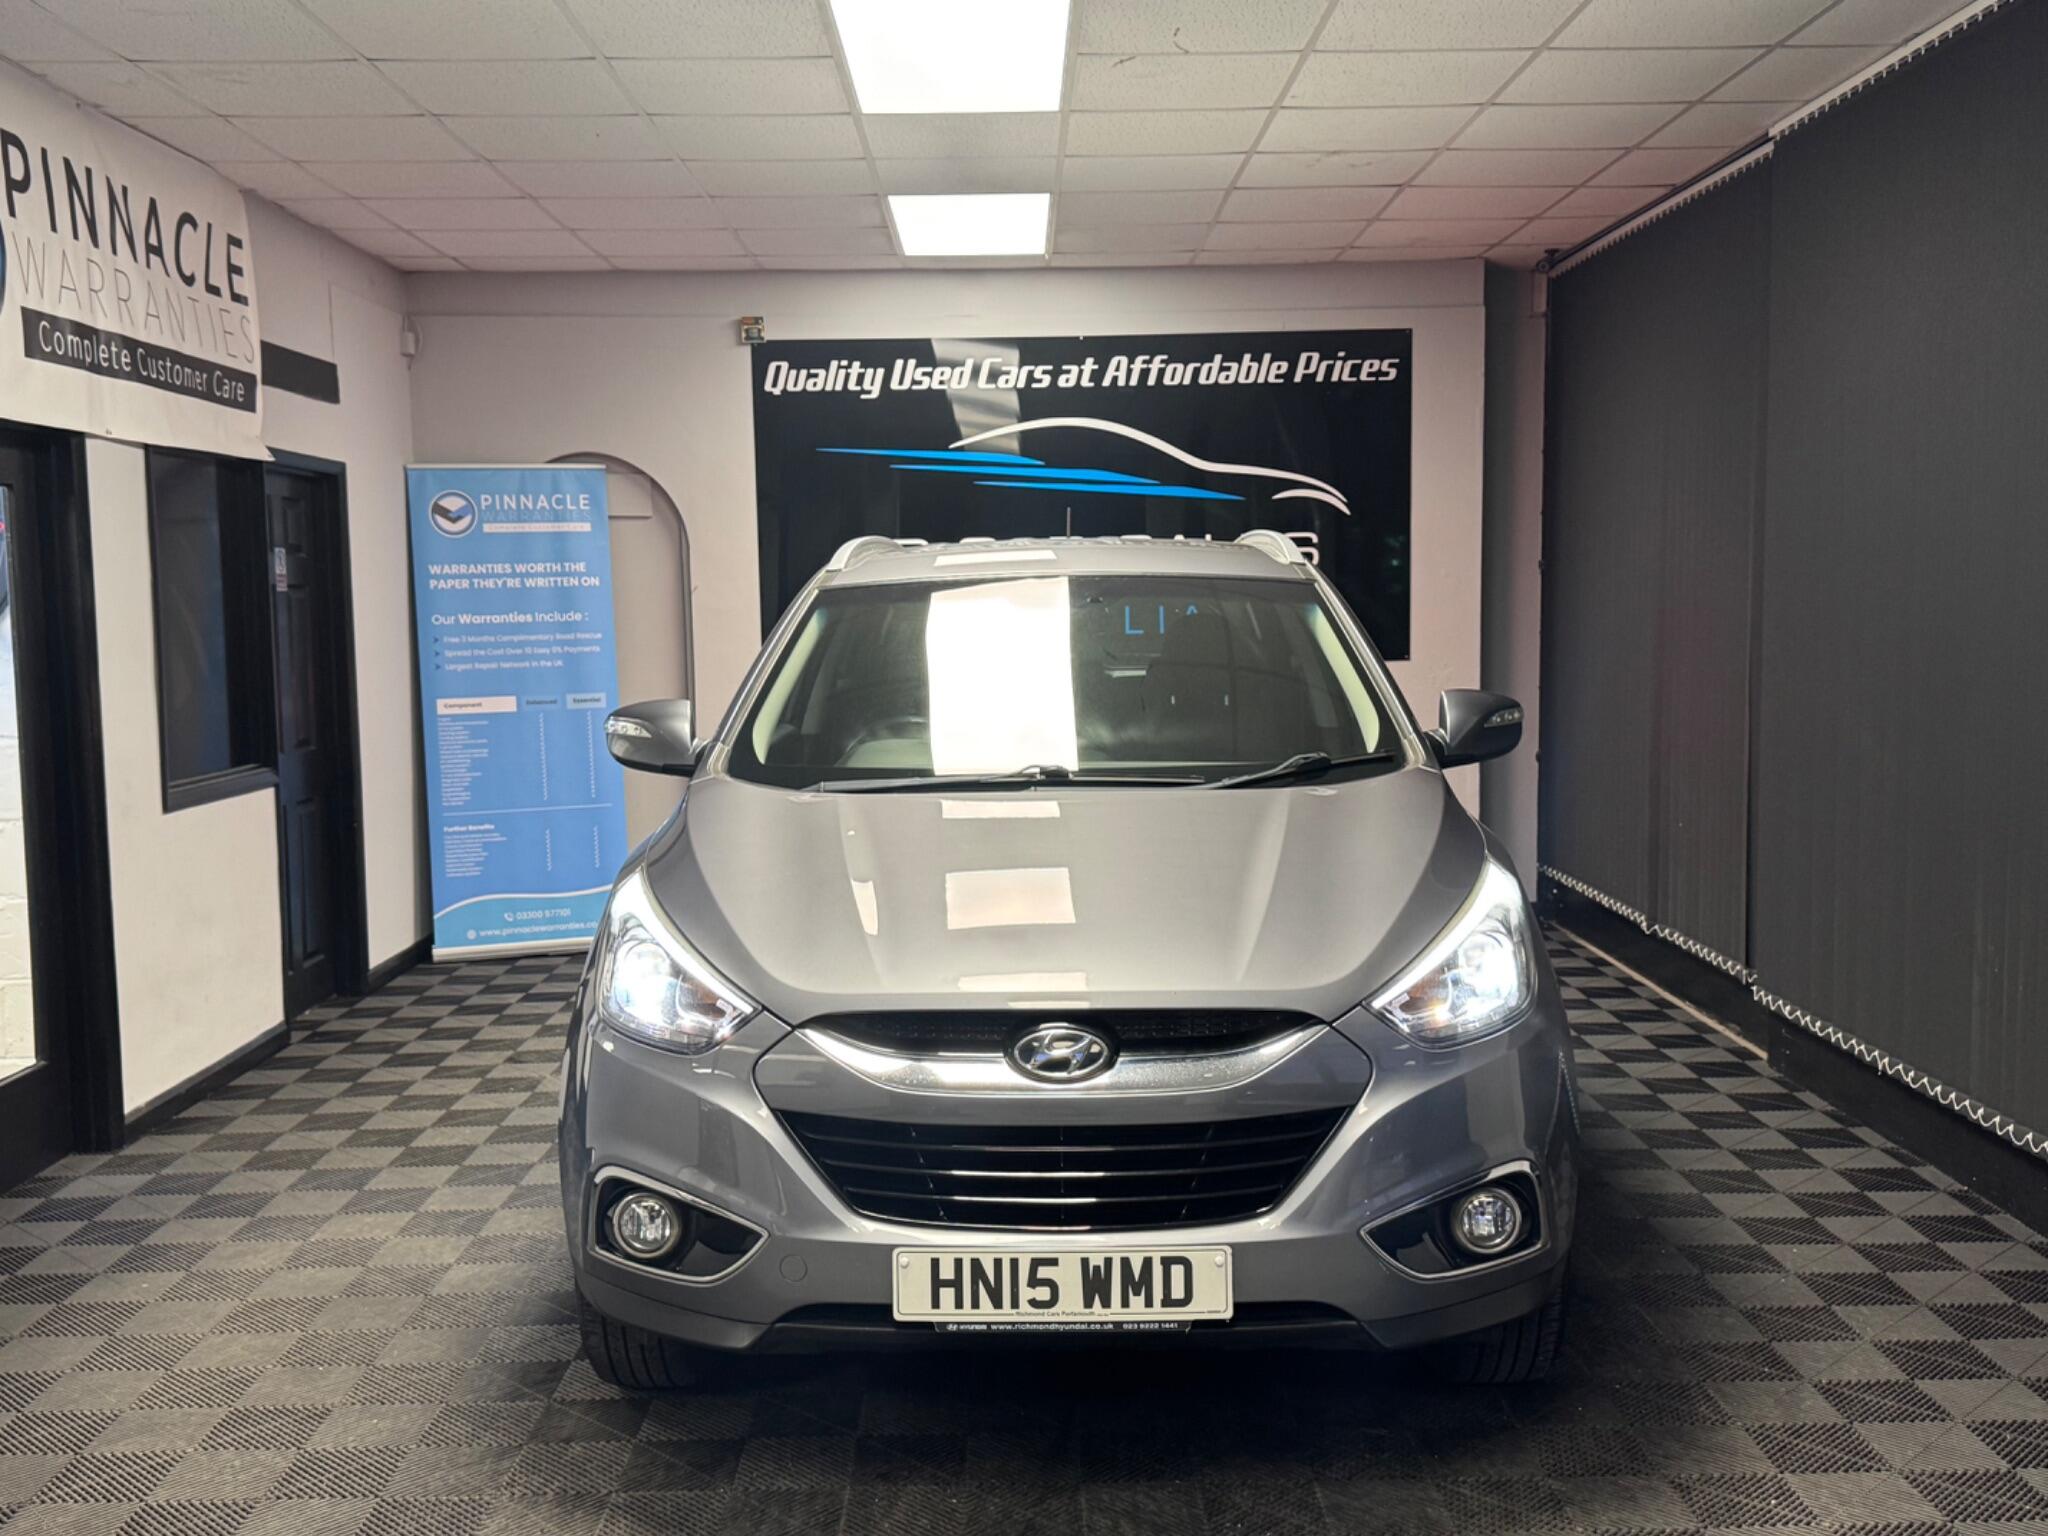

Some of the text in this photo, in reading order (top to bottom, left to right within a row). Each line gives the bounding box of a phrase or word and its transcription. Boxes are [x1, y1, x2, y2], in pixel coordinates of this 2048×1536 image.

[0, 127, 250, 307] PINNACLE
[11, 231, 255, 364] WARRANTIES
[38, 320, 246, 402] Complete Customer Care
[764, 352, 1400, 399] Quality Used Cars at Affordable Prices
[480, 493, 591, 510] PINNACLE
[428, 561, 587, 575] WARRANTIES WORTH THE
[429, 576, 600, 590] PAPER THEY'RE WRITTEN ON
[431, 614, 455, 625] Our
[458, 612, 533, 625] Warranties
[535, 610, 582, 623] Include
[930, 1255, 1194, 1310] HN15 WMD
